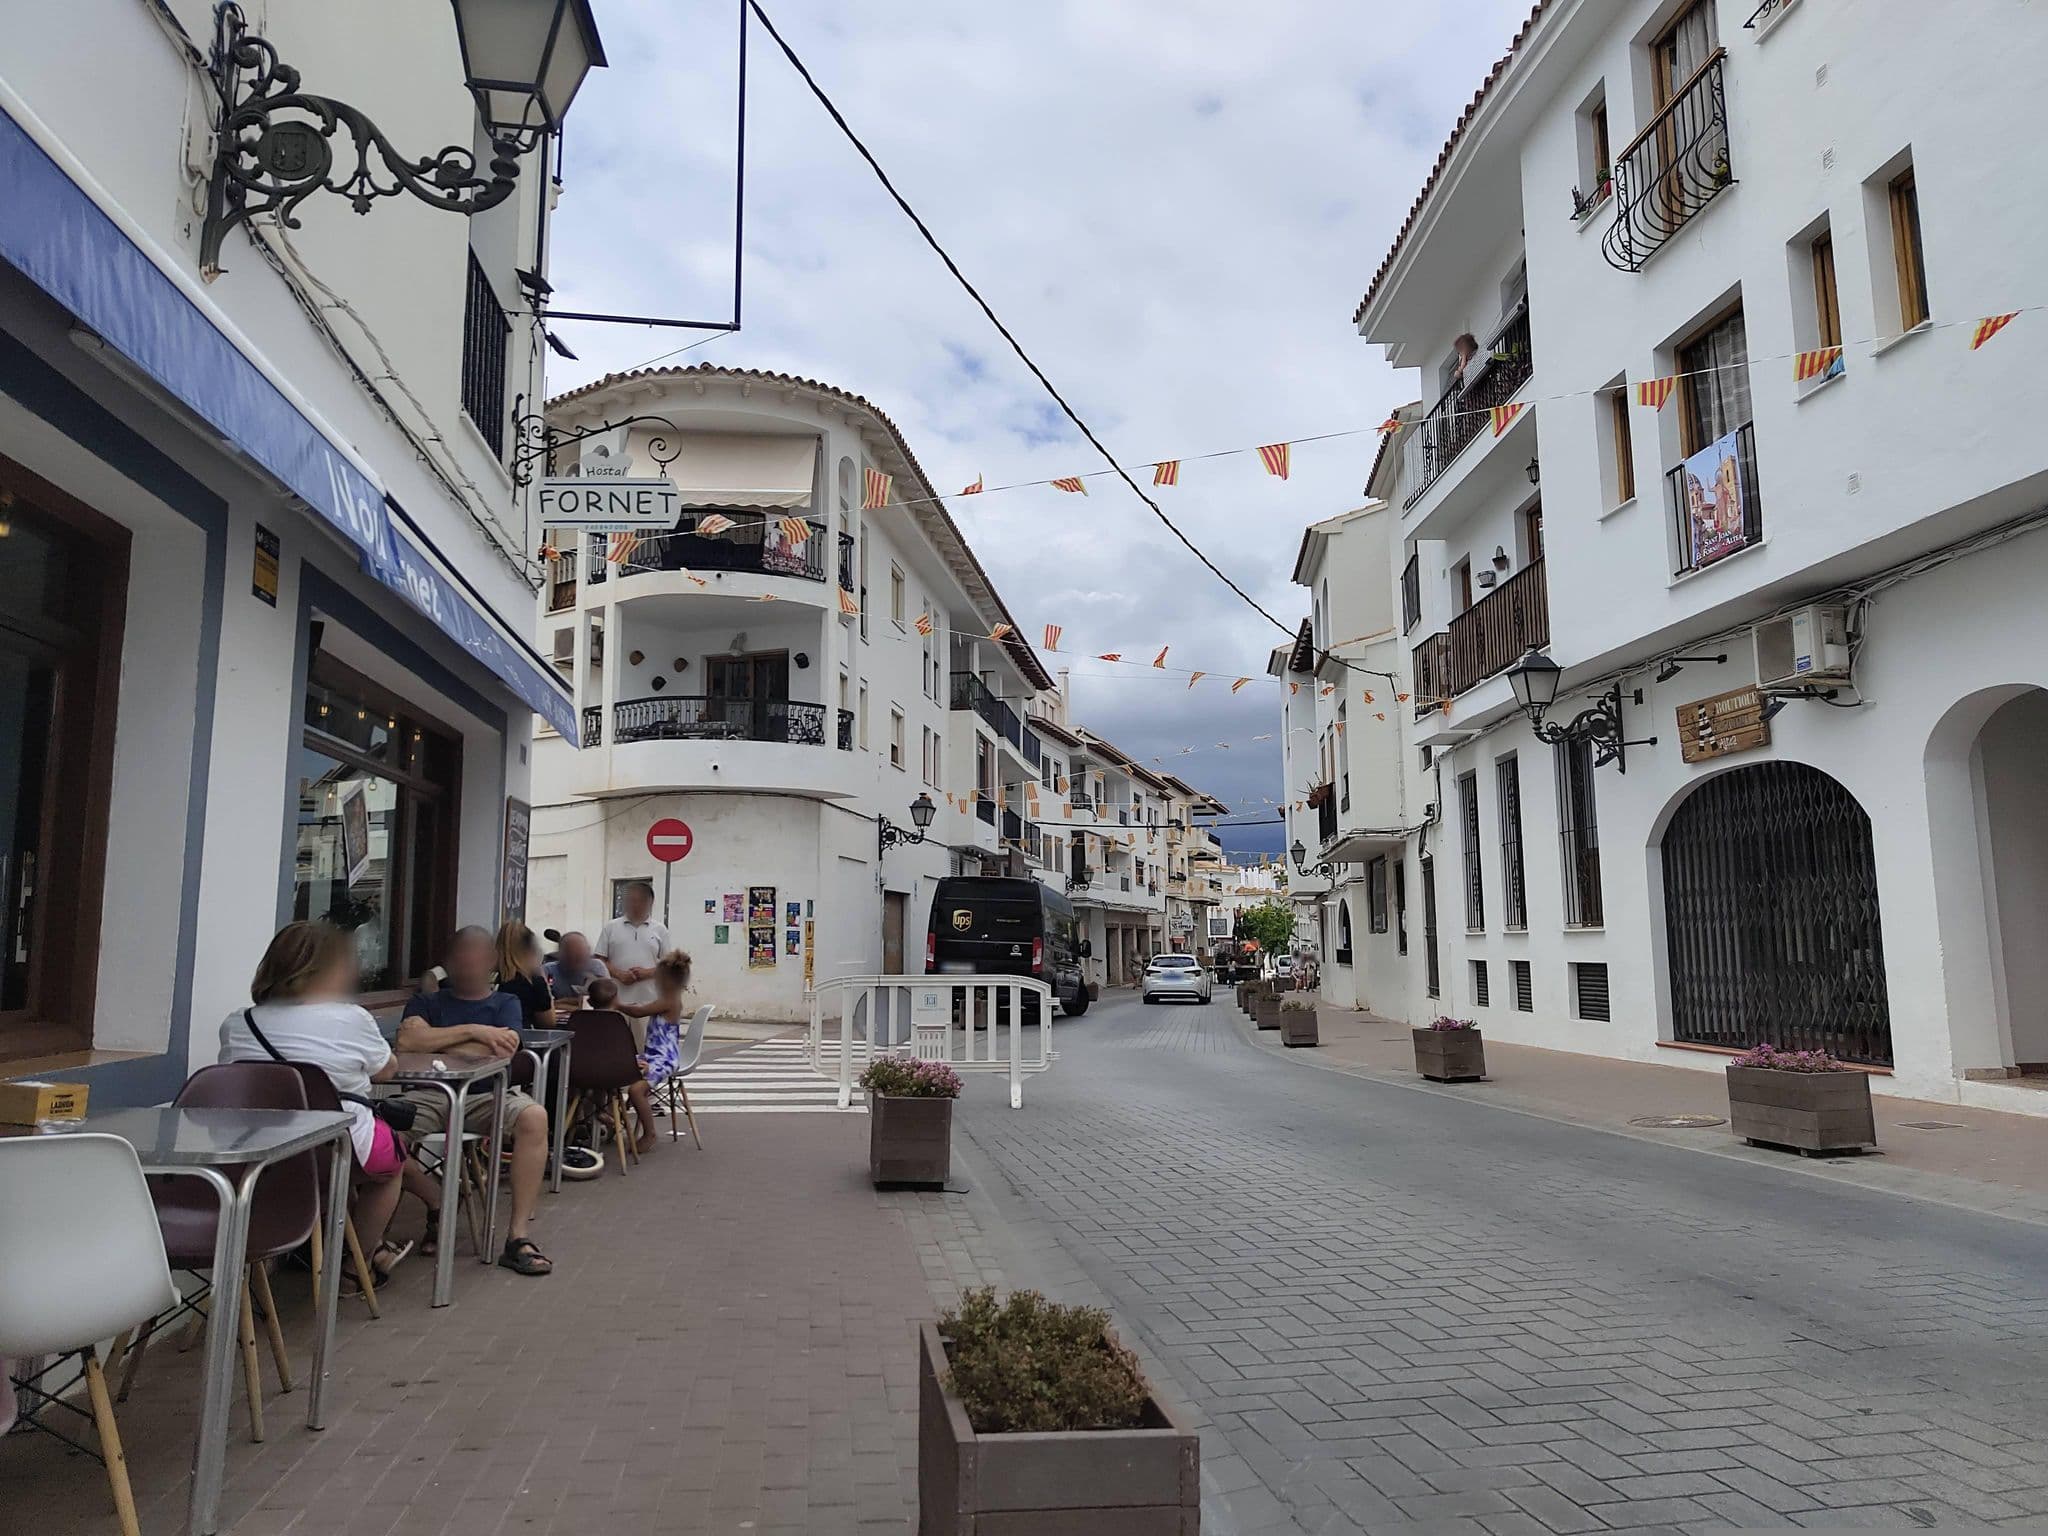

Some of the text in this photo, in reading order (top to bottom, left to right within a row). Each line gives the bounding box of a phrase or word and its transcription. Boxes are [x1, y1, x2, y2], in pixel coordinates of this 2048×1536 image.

[586, 466, 628, 477] Hostal
[539, 490, 678, 514] FORNET
[1715, 691, 1759, 715] BOUTIQUE
[954, 914, 971, 928] ups
